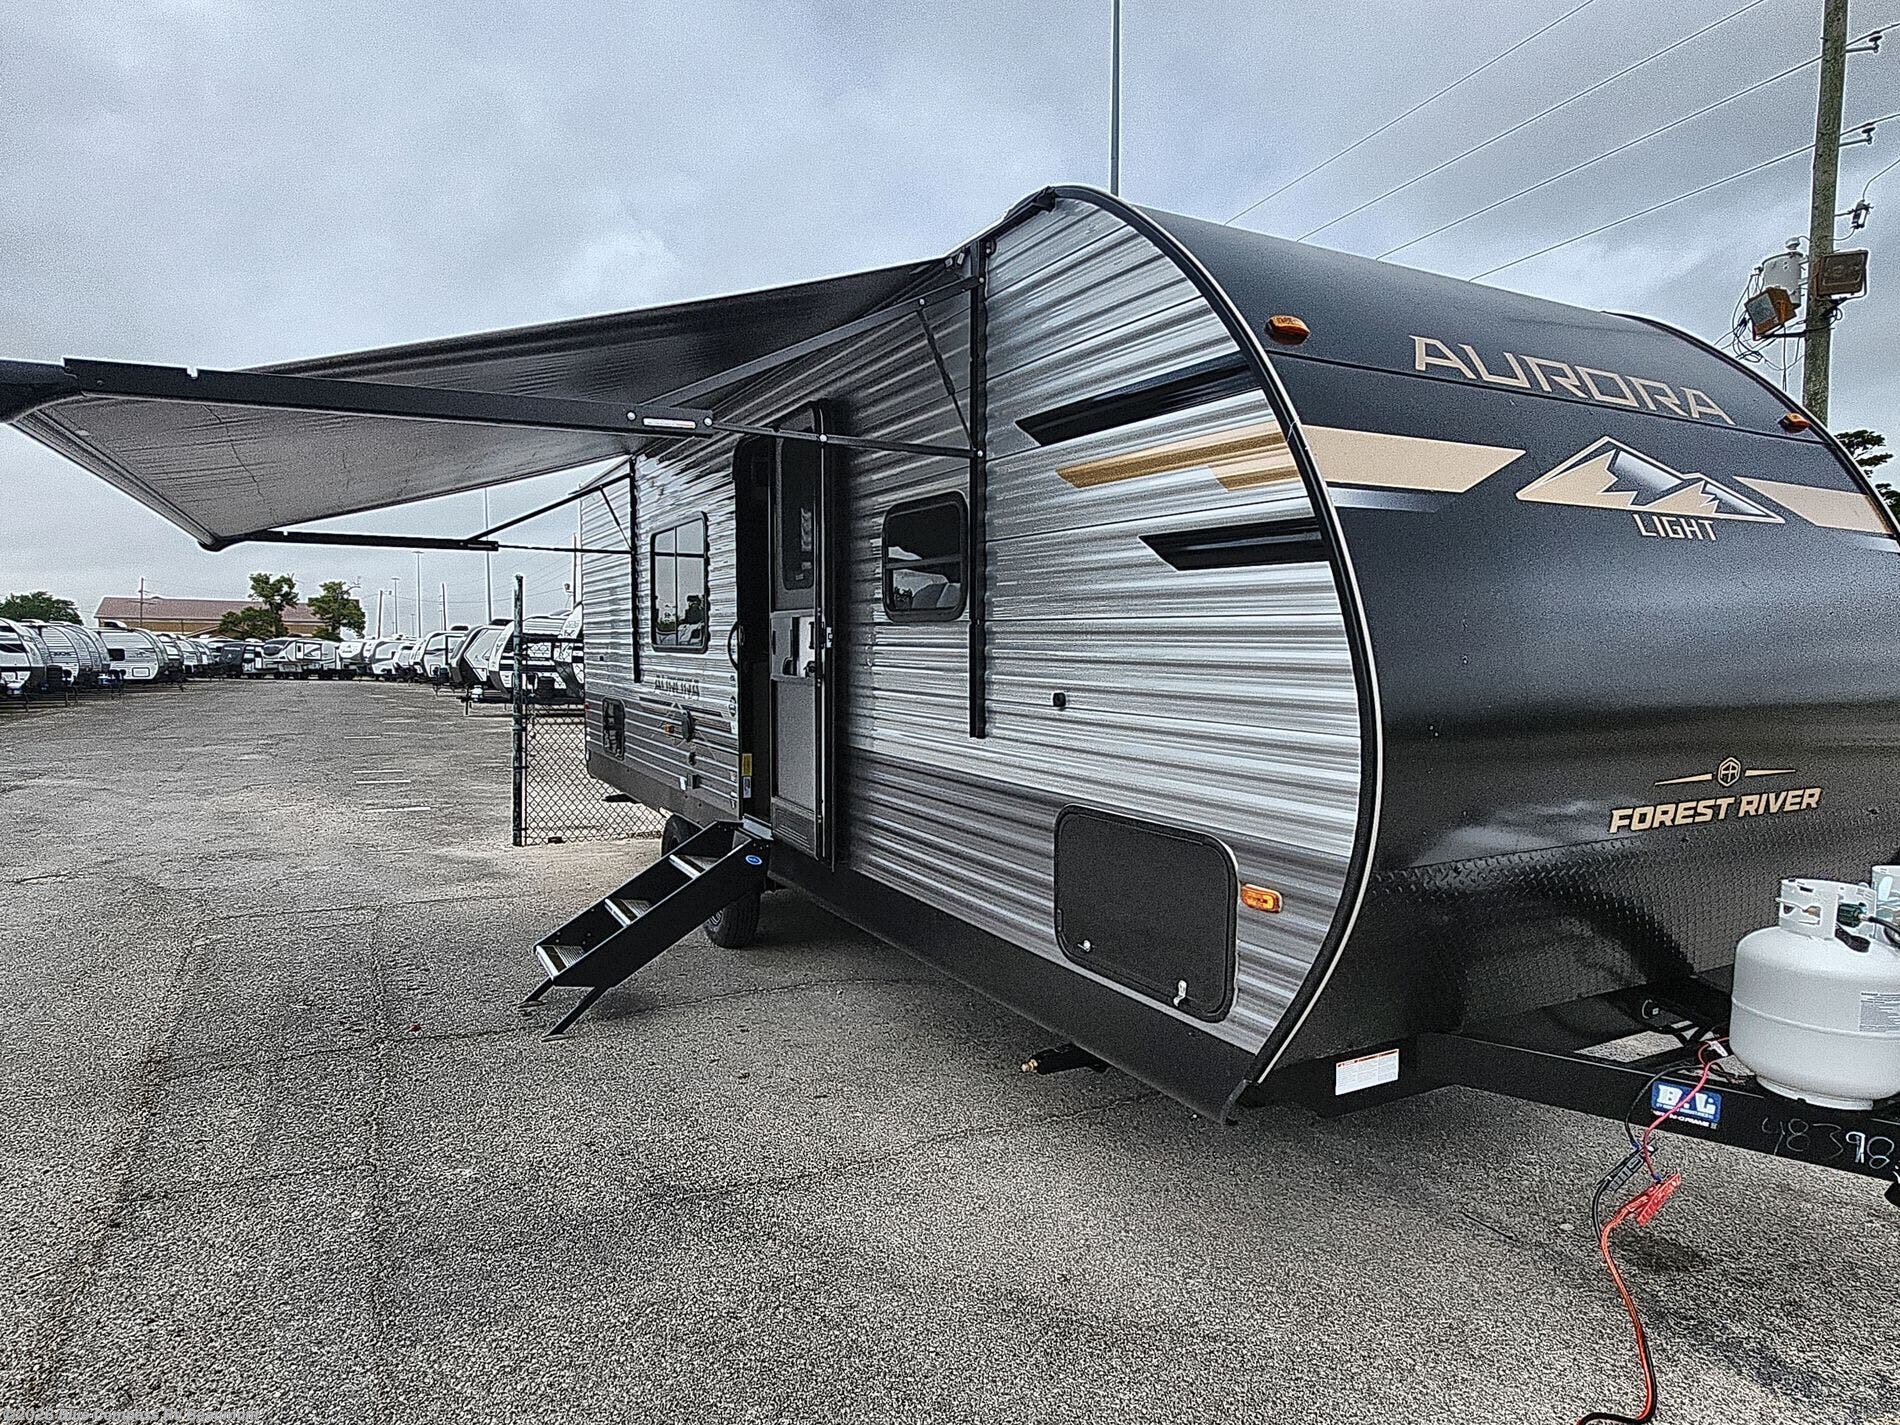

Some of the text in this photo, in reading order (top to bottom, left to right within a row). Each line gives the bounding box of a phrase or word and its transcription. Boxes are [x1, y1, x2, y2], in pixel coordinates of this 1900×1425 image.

[1409, 335, 1736, 425] AURORA
[1632, 513, 1718, 541] LIGHT
[1608, 787, 1822, 833] FOREST RIVER
